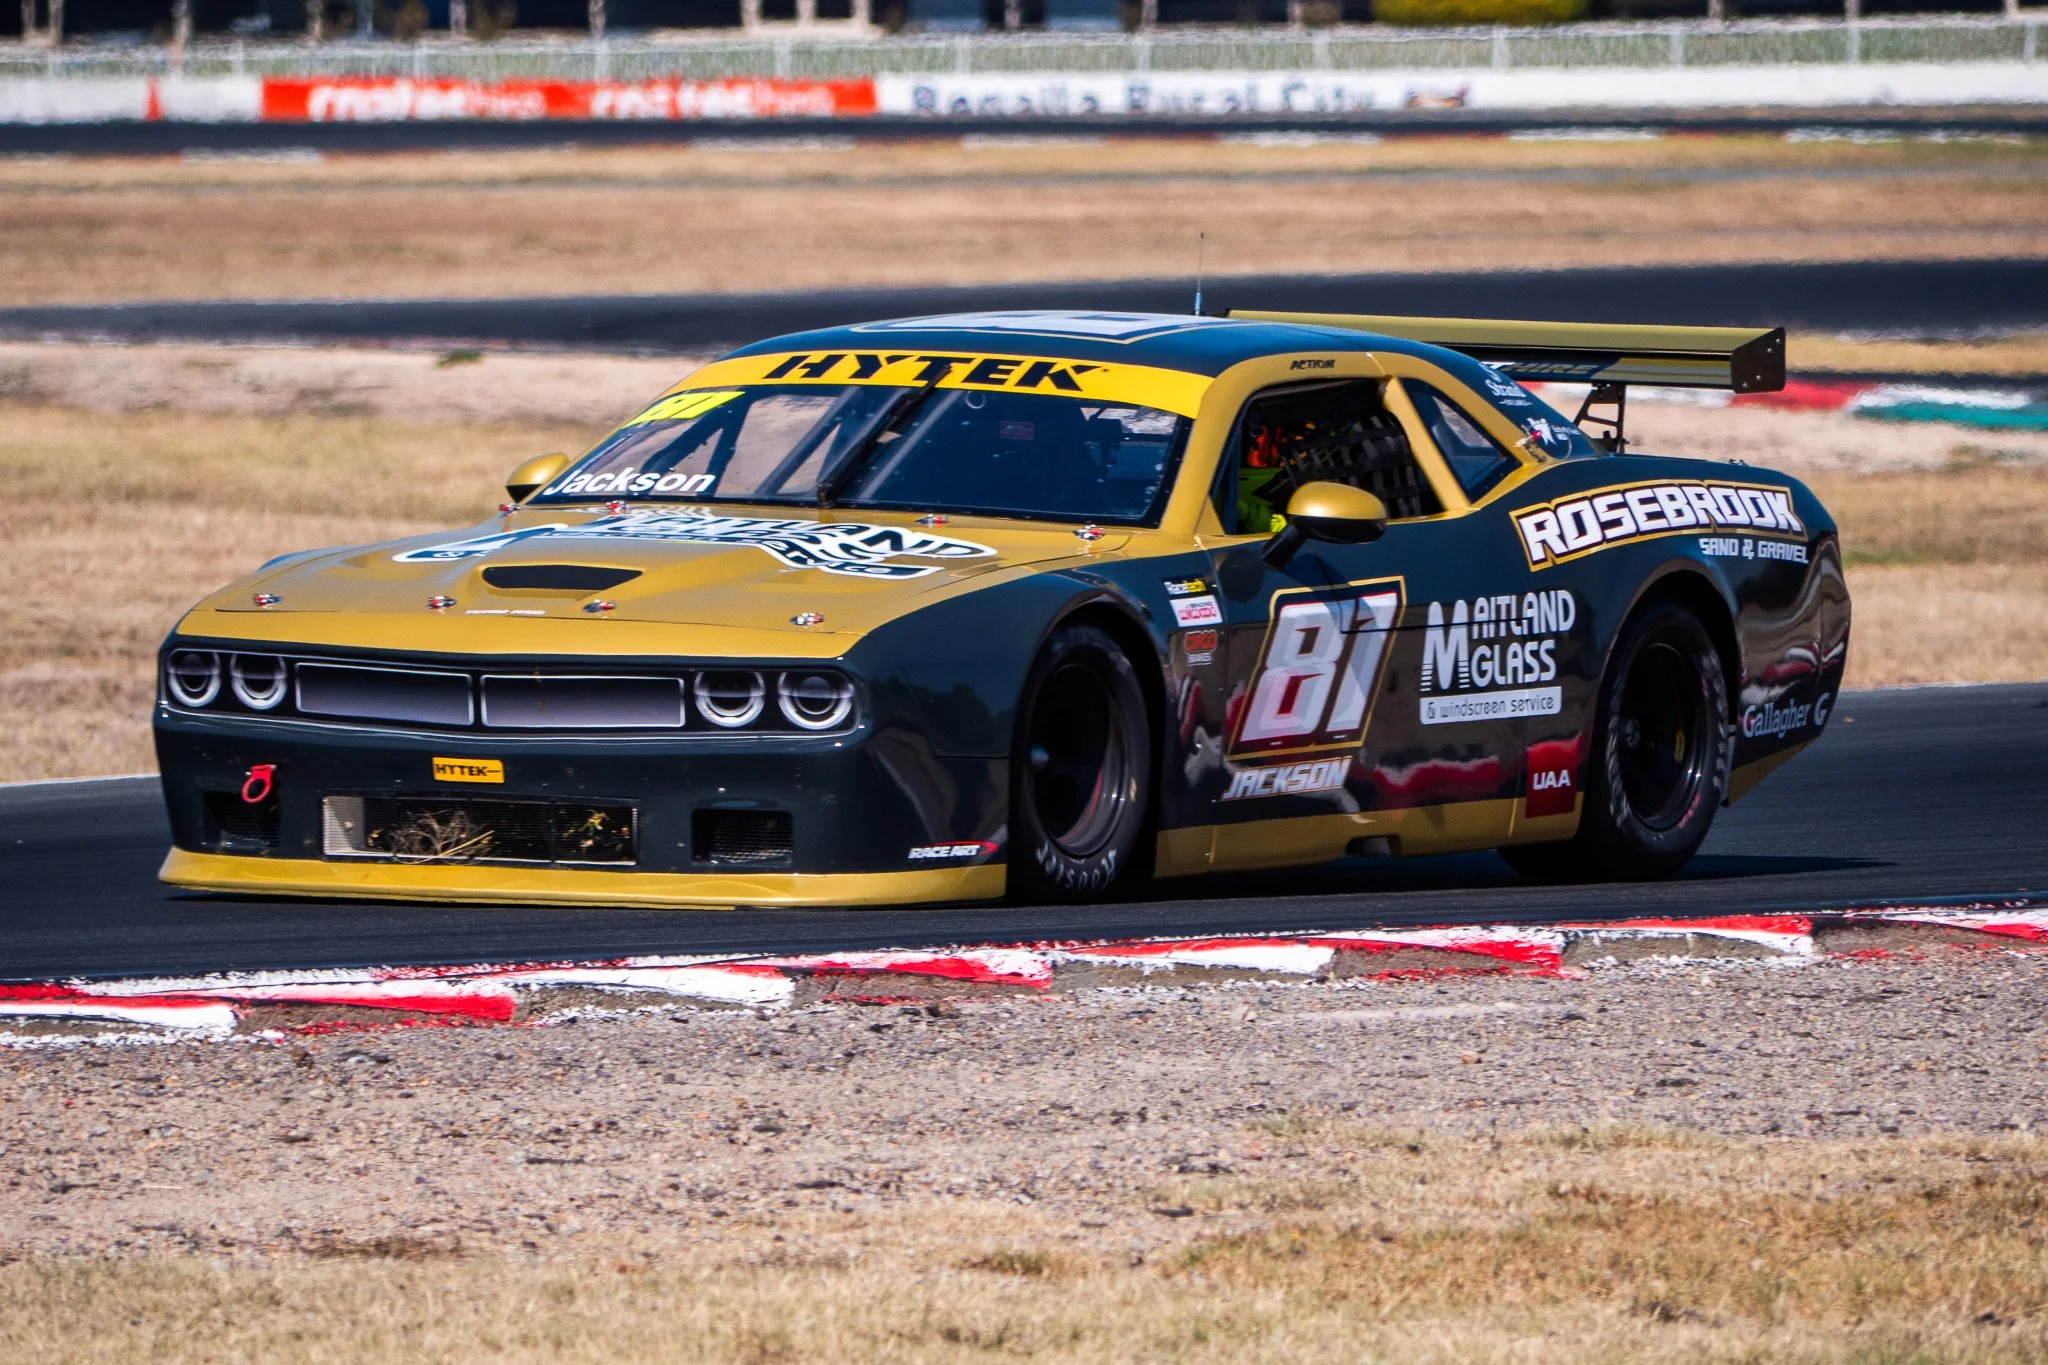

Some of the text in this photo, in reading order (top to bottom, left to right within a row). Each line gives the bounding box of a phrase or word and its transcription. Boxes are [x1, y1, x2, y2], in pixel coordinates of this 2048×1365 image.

[762, 353, 1103, 392] HYTEK
[543, 467, 716, 496] Jackson
[1518, 483, 1804, 563] ROSEBROOK
[1698, 537, 1809, 564] SAND & GRAVEL
[1420, 589, 1577, 692] MAITLAND
[1239, 592, 1398, 742] 81
[1471, 639, 1557, 688] GLASS
[1426, 695, 1555, 719] & windscreen service
[1743, 699, 1812, 738] Gallagher
[436, 763, 488, 778] HYTEK
[1222, 756, 1353, 799] JACKSON
[907, 844, 981, 859] RACE ART
